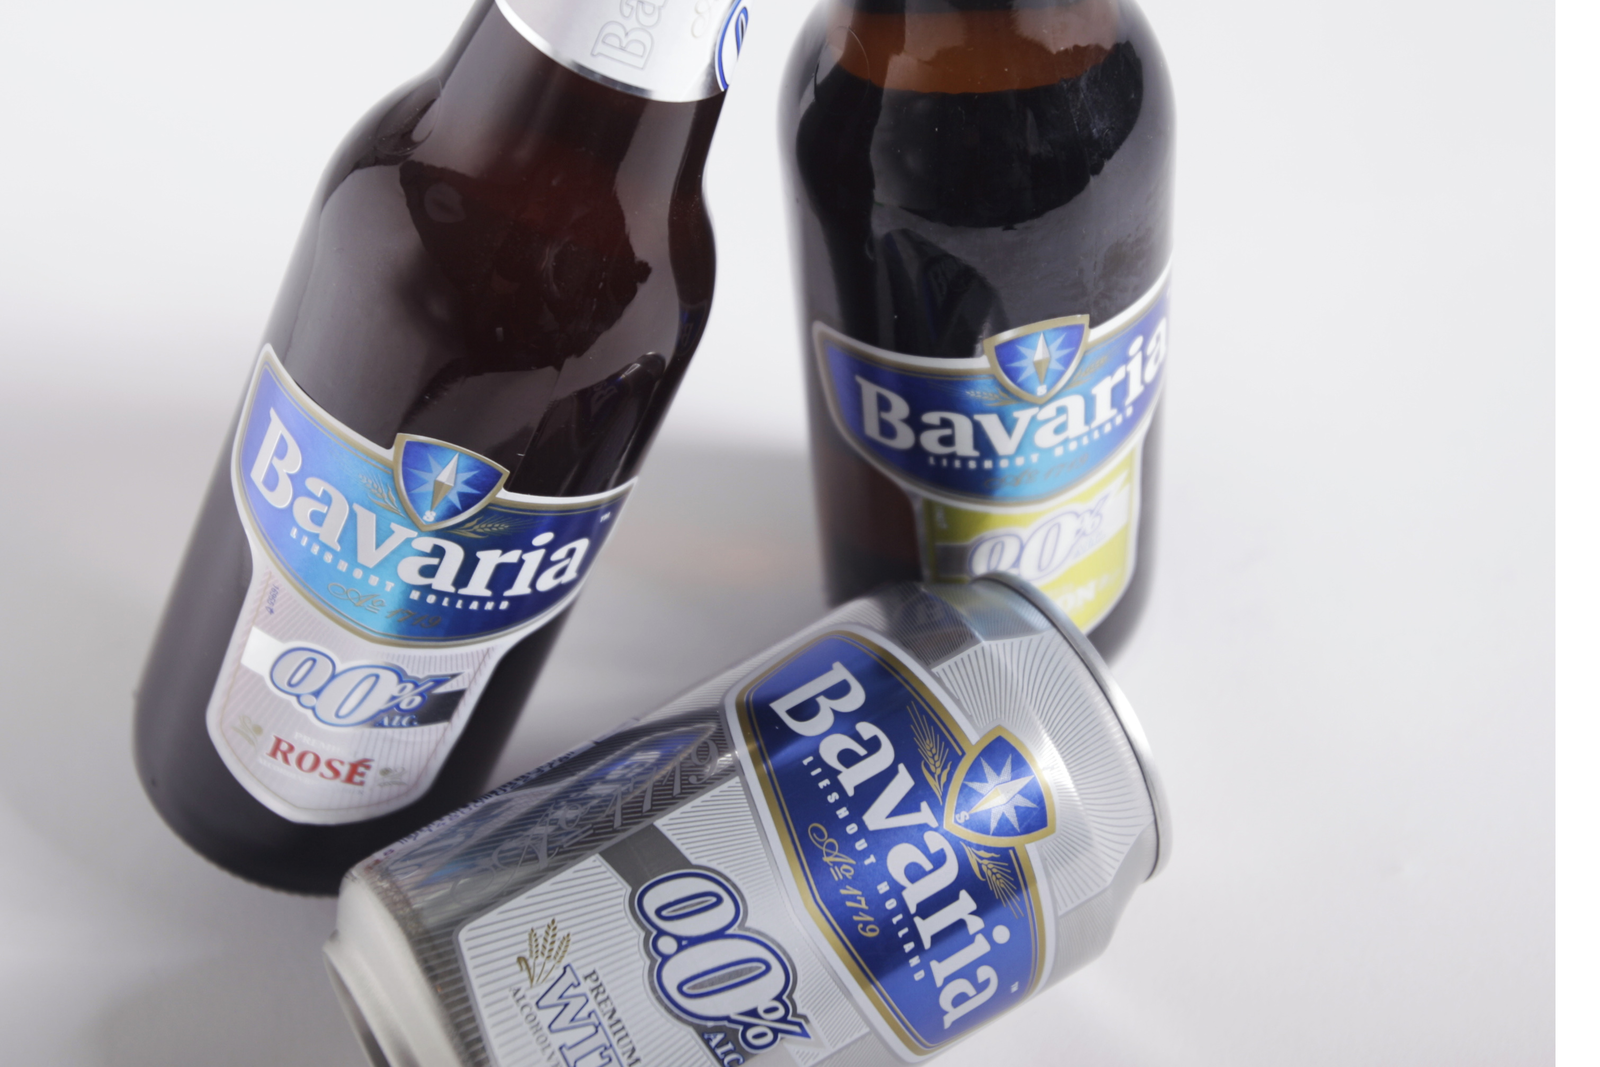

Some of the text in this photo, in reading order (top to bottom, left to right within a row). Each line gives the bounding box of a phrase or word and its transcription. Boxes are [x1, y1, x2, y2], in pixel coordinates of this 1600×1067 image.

[855, 317, 1167, 457] Bavaria
[250, 406, 591, 598] Bavaria
[929, 453, 1040, 469] LIESHOUT
[289, 526, 510, 611] LIESHOUT HOLLAND
[385, 606, 443, 630] 1719
[269, 646, 450, 728] 0.0%
[266, 734, 375, 787] ROSÉ
[769, 661, 1011, 1030] Bavaria
[802, 756, 926, 982] LIESHOUT HOLLAND
[839, 885, 880, 938] 1719
[635, 869, 812, 1051] 0.0%
[583, 968, 642, 1067] PREMIUM
